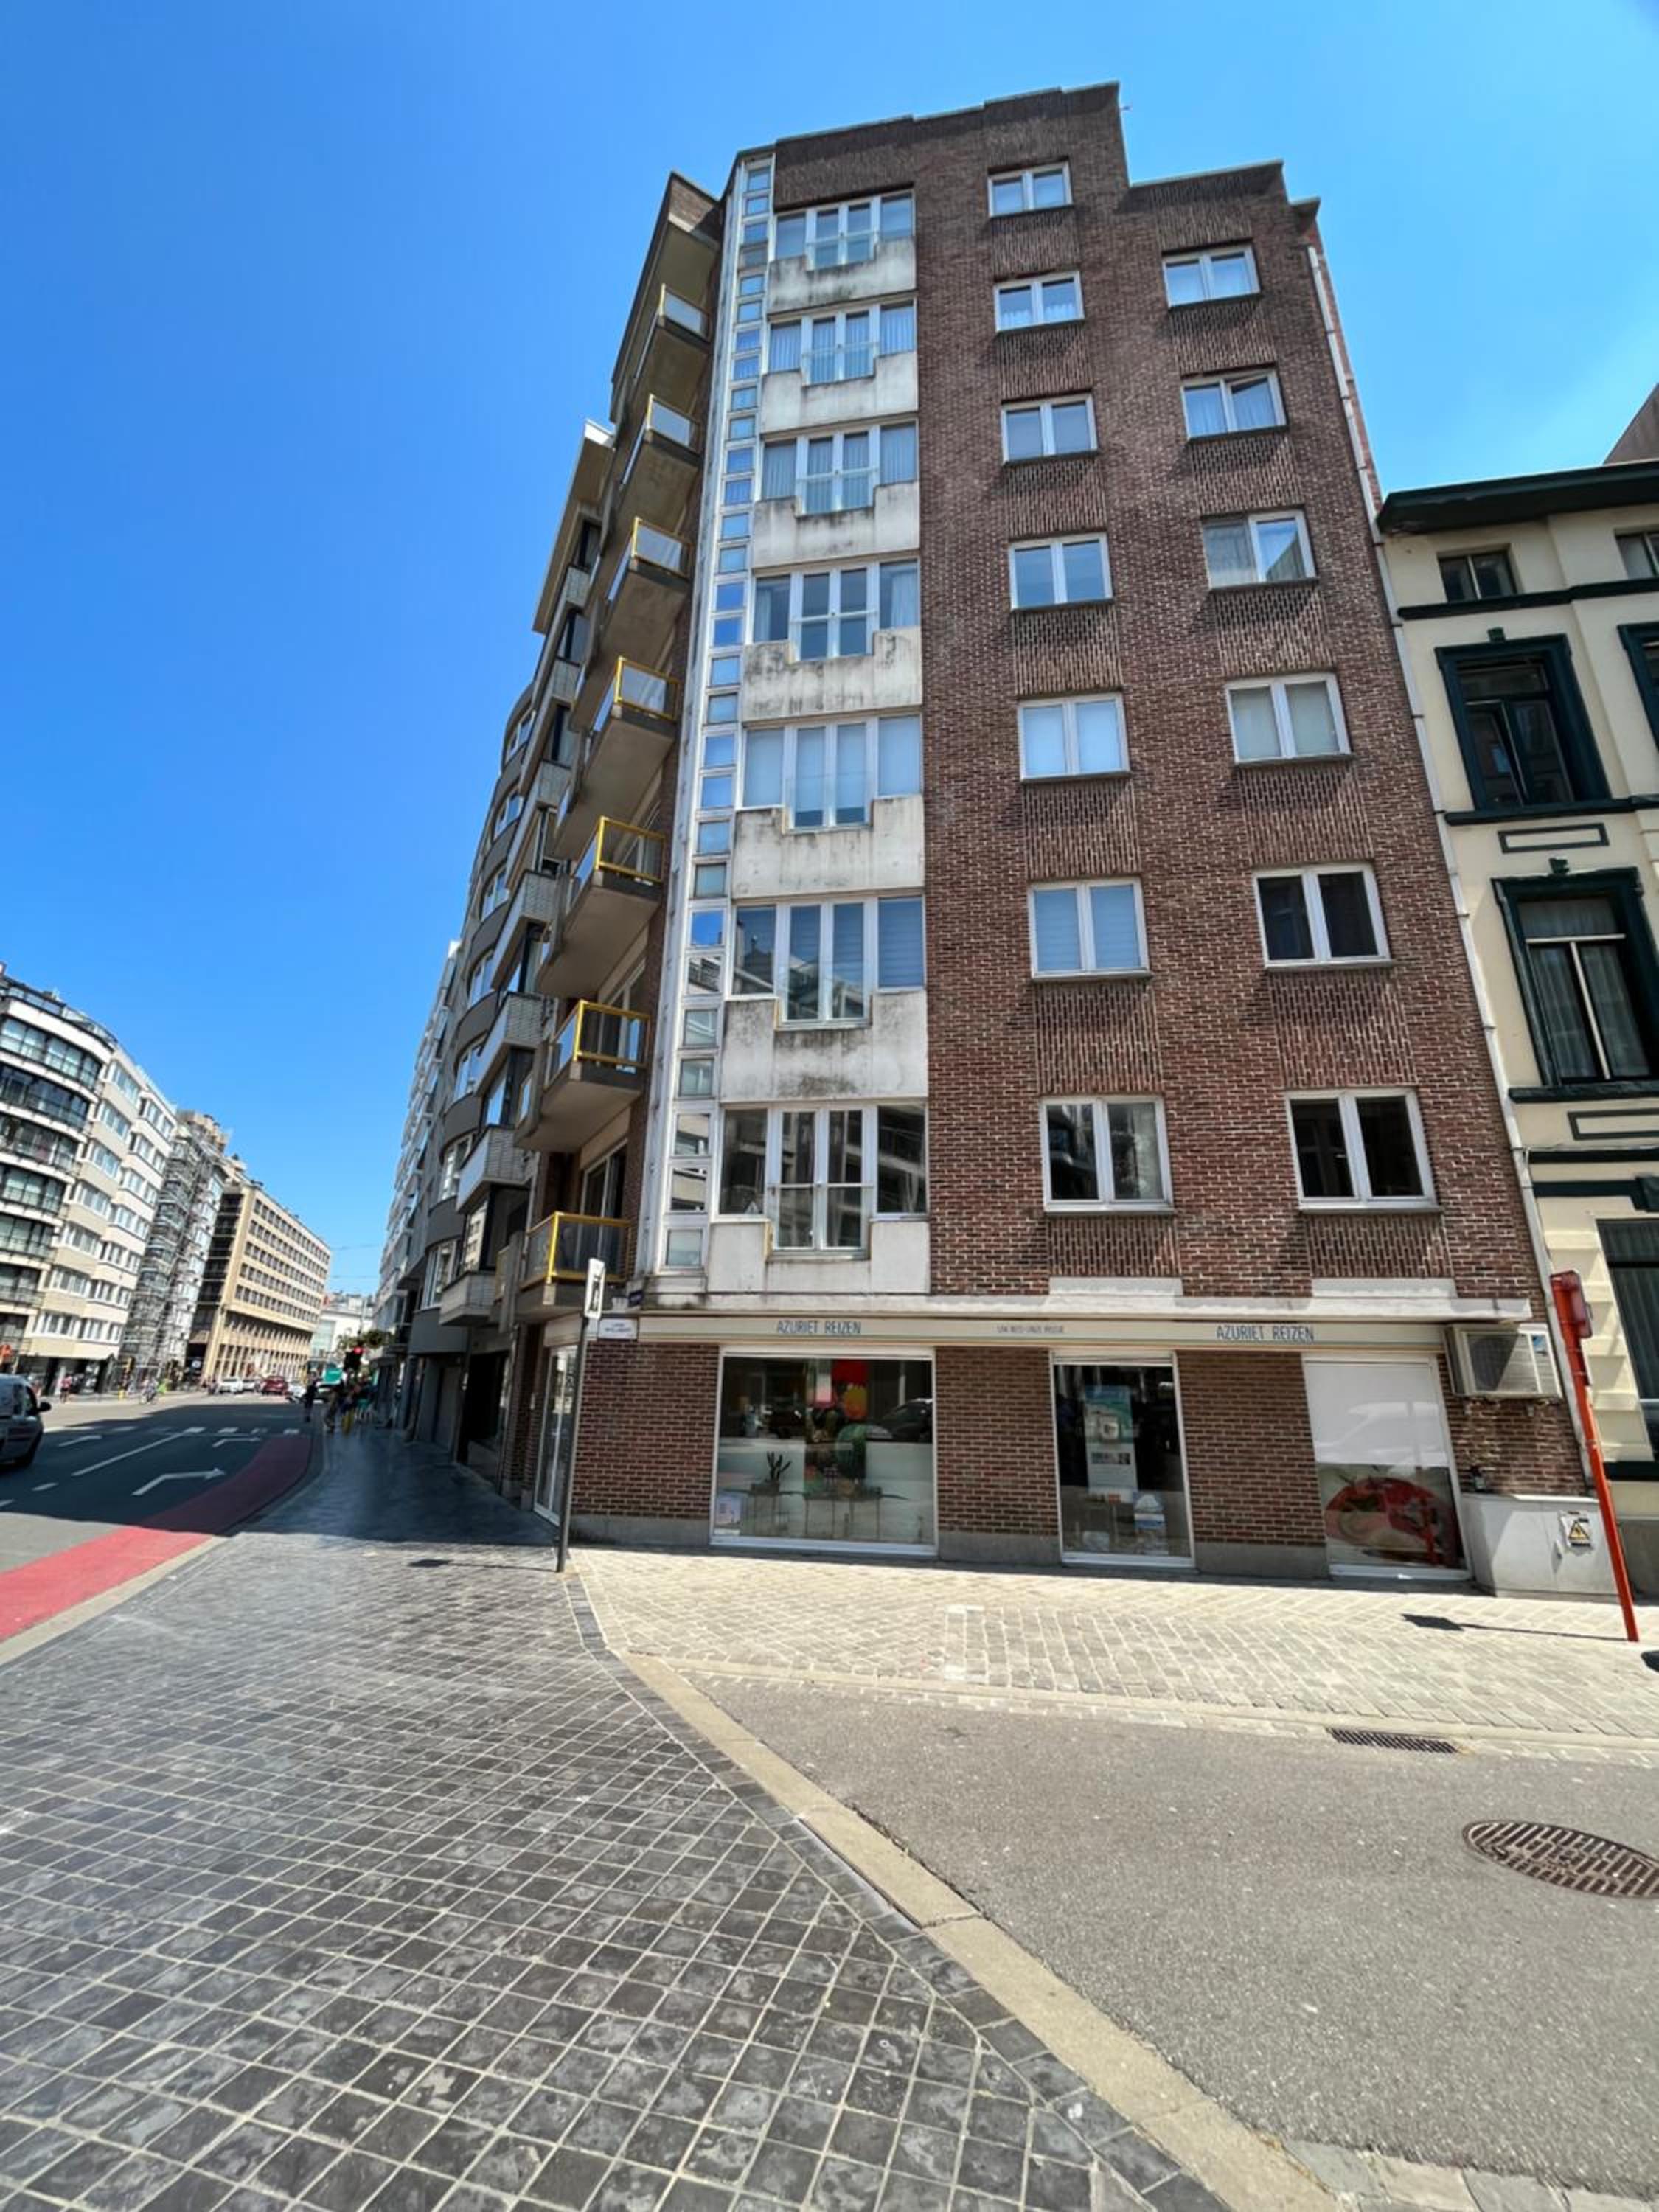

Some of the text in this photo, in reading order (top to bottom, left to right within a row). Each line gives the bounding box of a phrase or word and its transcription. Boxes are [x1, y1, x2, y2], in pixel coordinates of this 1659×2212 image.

[777, 1320, 861, 1335] AZURIET REIZEN
[1216, 1325, 1315, 1343] AZURIET REIZEN
